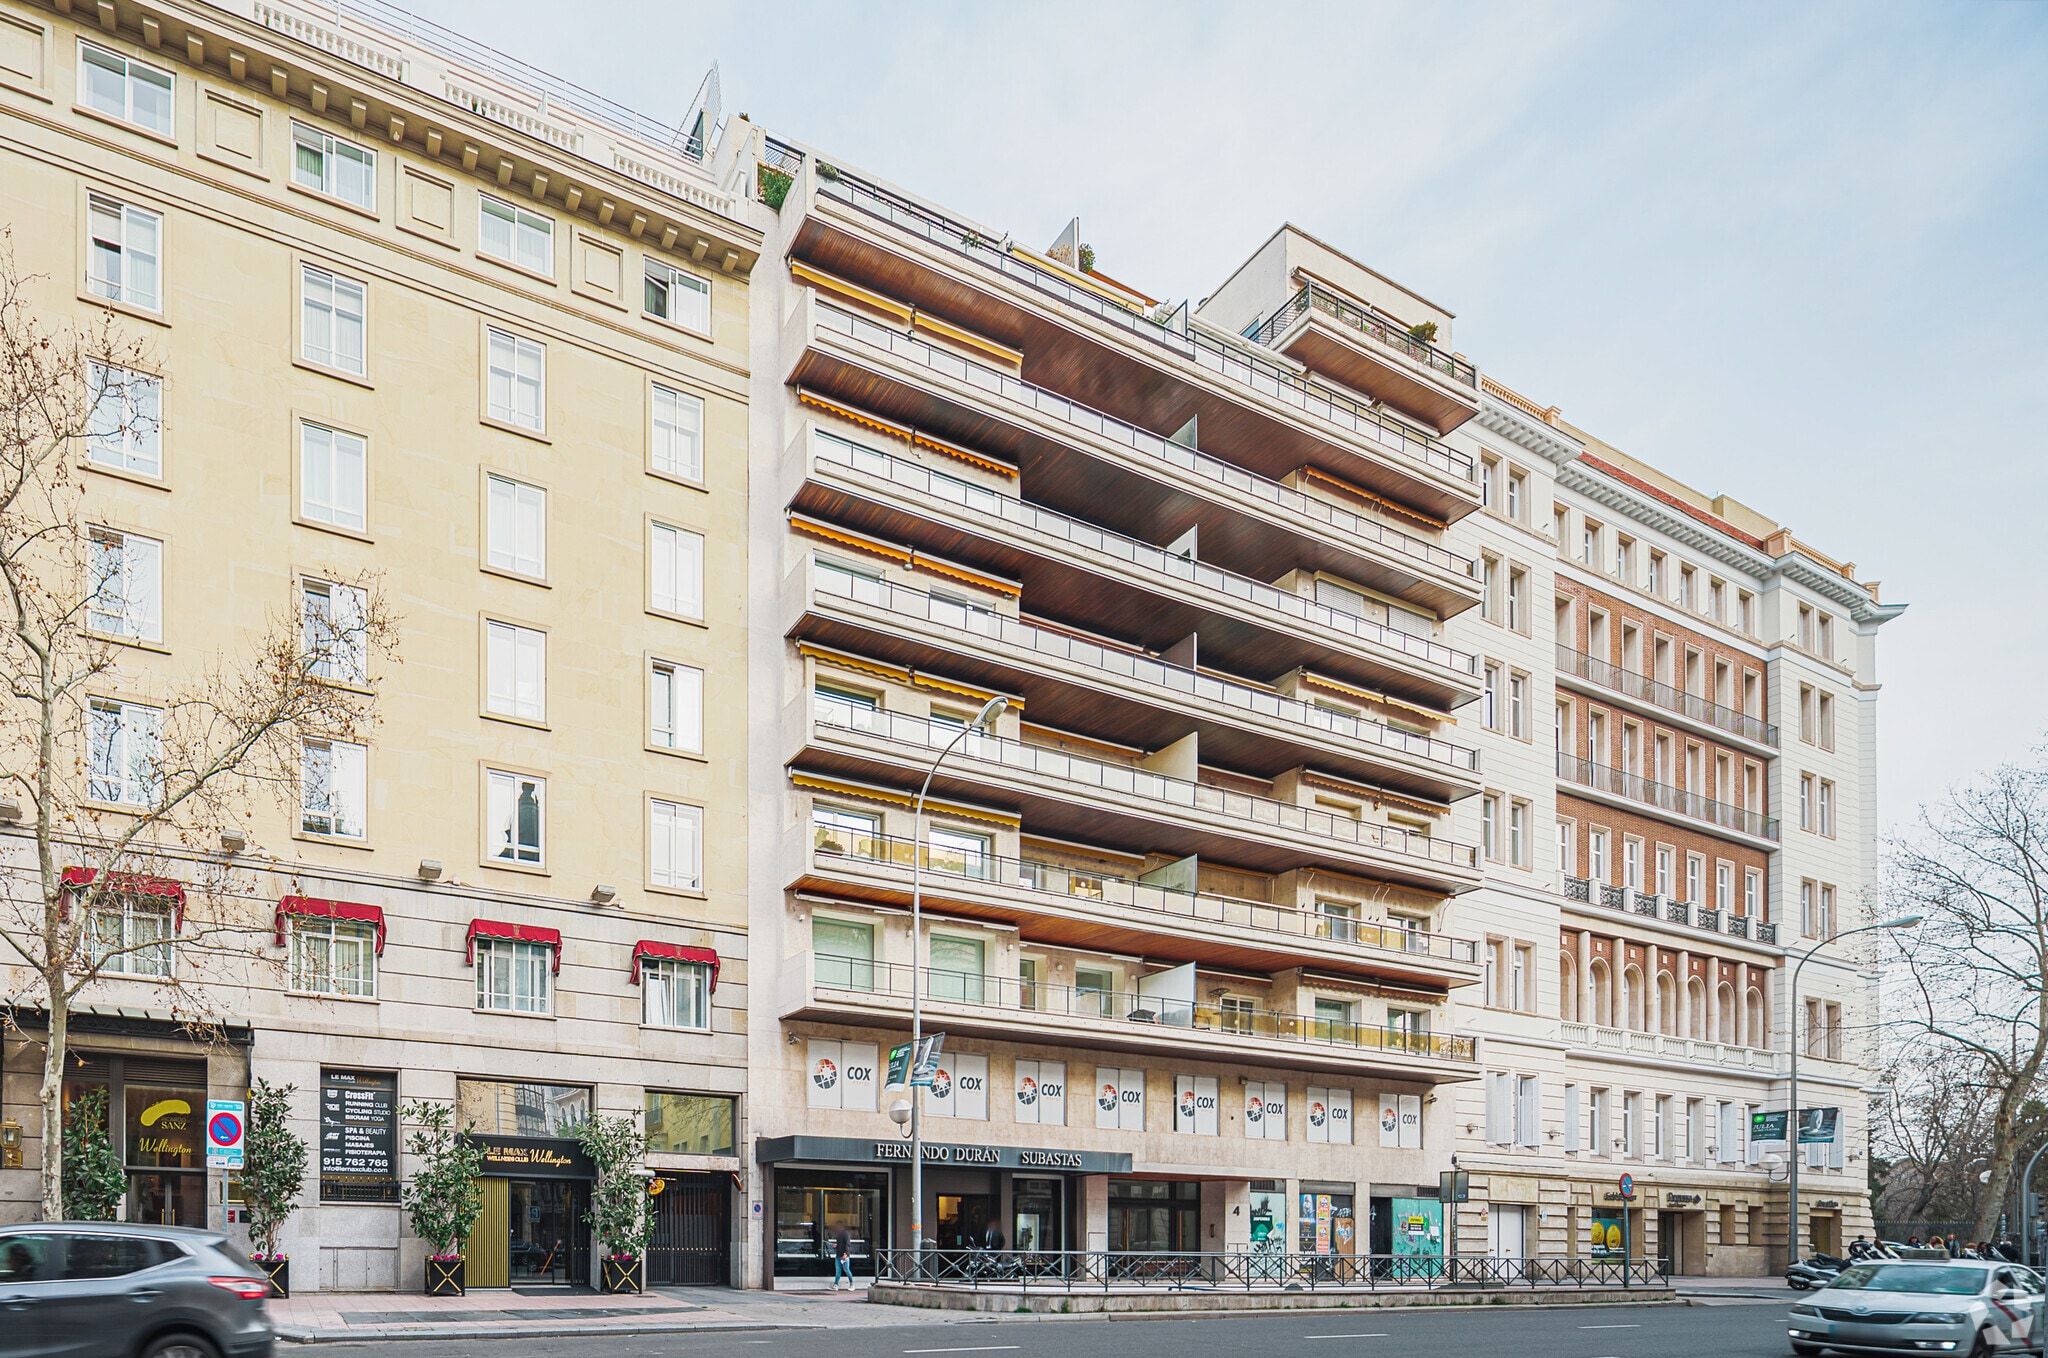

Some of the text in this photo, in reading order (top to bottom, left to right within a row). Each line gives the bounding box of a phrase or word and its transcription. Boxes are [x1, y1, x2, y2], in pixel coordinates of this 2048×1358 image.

[847, 1066, 872, 1081] COX
[960, 1076, 982, 1091] COX
[1041, 1083, 1062, 1097] COX
[1121, 1090, 1141, 1103] COX
[1196, 1096, 1215, 1109] COX
[1266, 1103, 1284, 1115] COX
[1331, 1108, 1348, 1119] COX
[161, 1121, 187, 1130] SANZ
[1402, 1114, 1417, 1125] COX
[140, 1138, 191, 1157] Wellington
[503, 1147, 528, 1156] MAX
[529, 1148, 572, 1168] Wellington
[876, 1143, 1082, 1167] FERNNDO DURÁN SUBASTAS
[323, 1157, 389, 1167] 915 762 766
[323, 1165, 388, 1173] info@lemaxclub.com
[1232, 1205, 1240, 1216] 4
